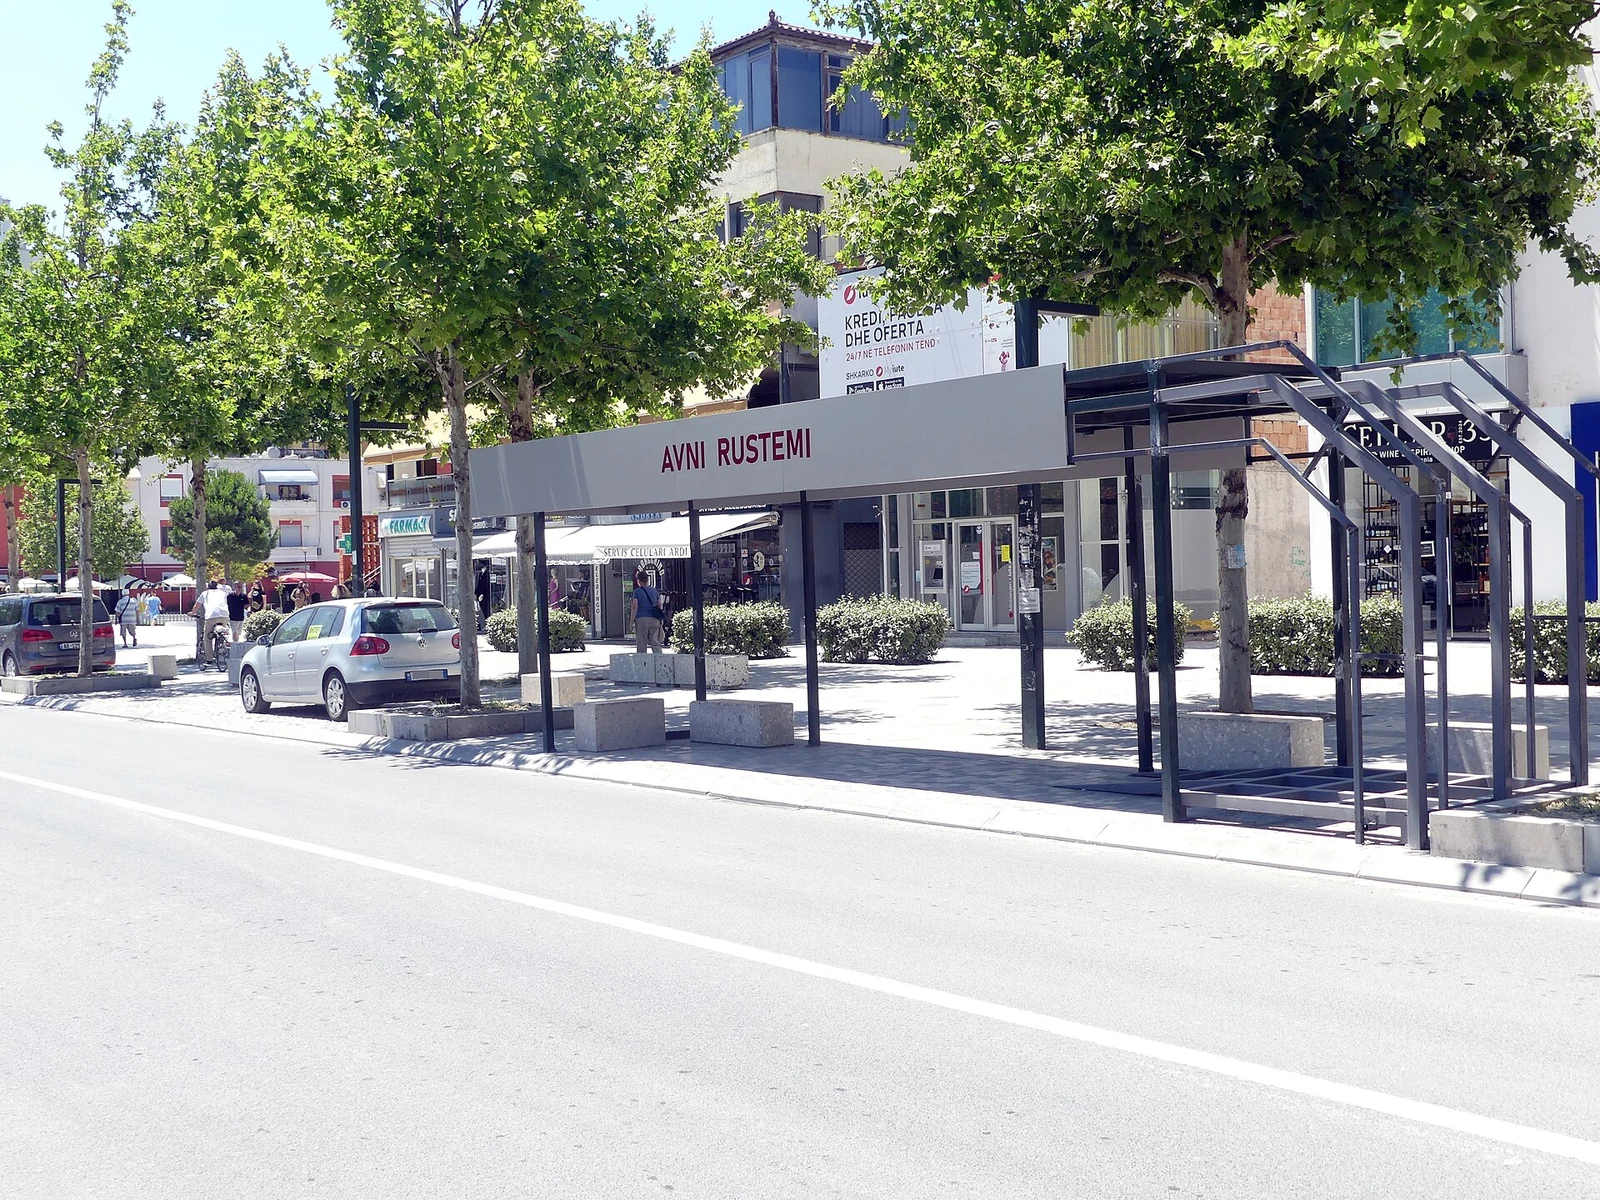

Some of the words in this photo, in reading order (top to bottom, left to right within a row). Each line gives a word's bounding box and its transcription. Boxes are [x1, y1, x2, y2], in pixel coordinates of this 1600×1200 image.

[845, 329, 871, 347] DHE
[873, 319, 924, 343] OFERTA
[846, 351, 862, 361] 24/7
[874, 342, 914, 357] TELEFONIN
[846, 368, 875, 380] SHKARKO
[661, 440, 706, 473] AVNI
[717, 427, 811, 467] RUSTEMI
[1379, 449, 1400, 459] WINE
[389, 517, 428, 535] FARMACI
[603, 547, 628, 557] SERVIS
[630, 547, 666, 558] CELULARI
[668, 546, 688, 557] ARDI
